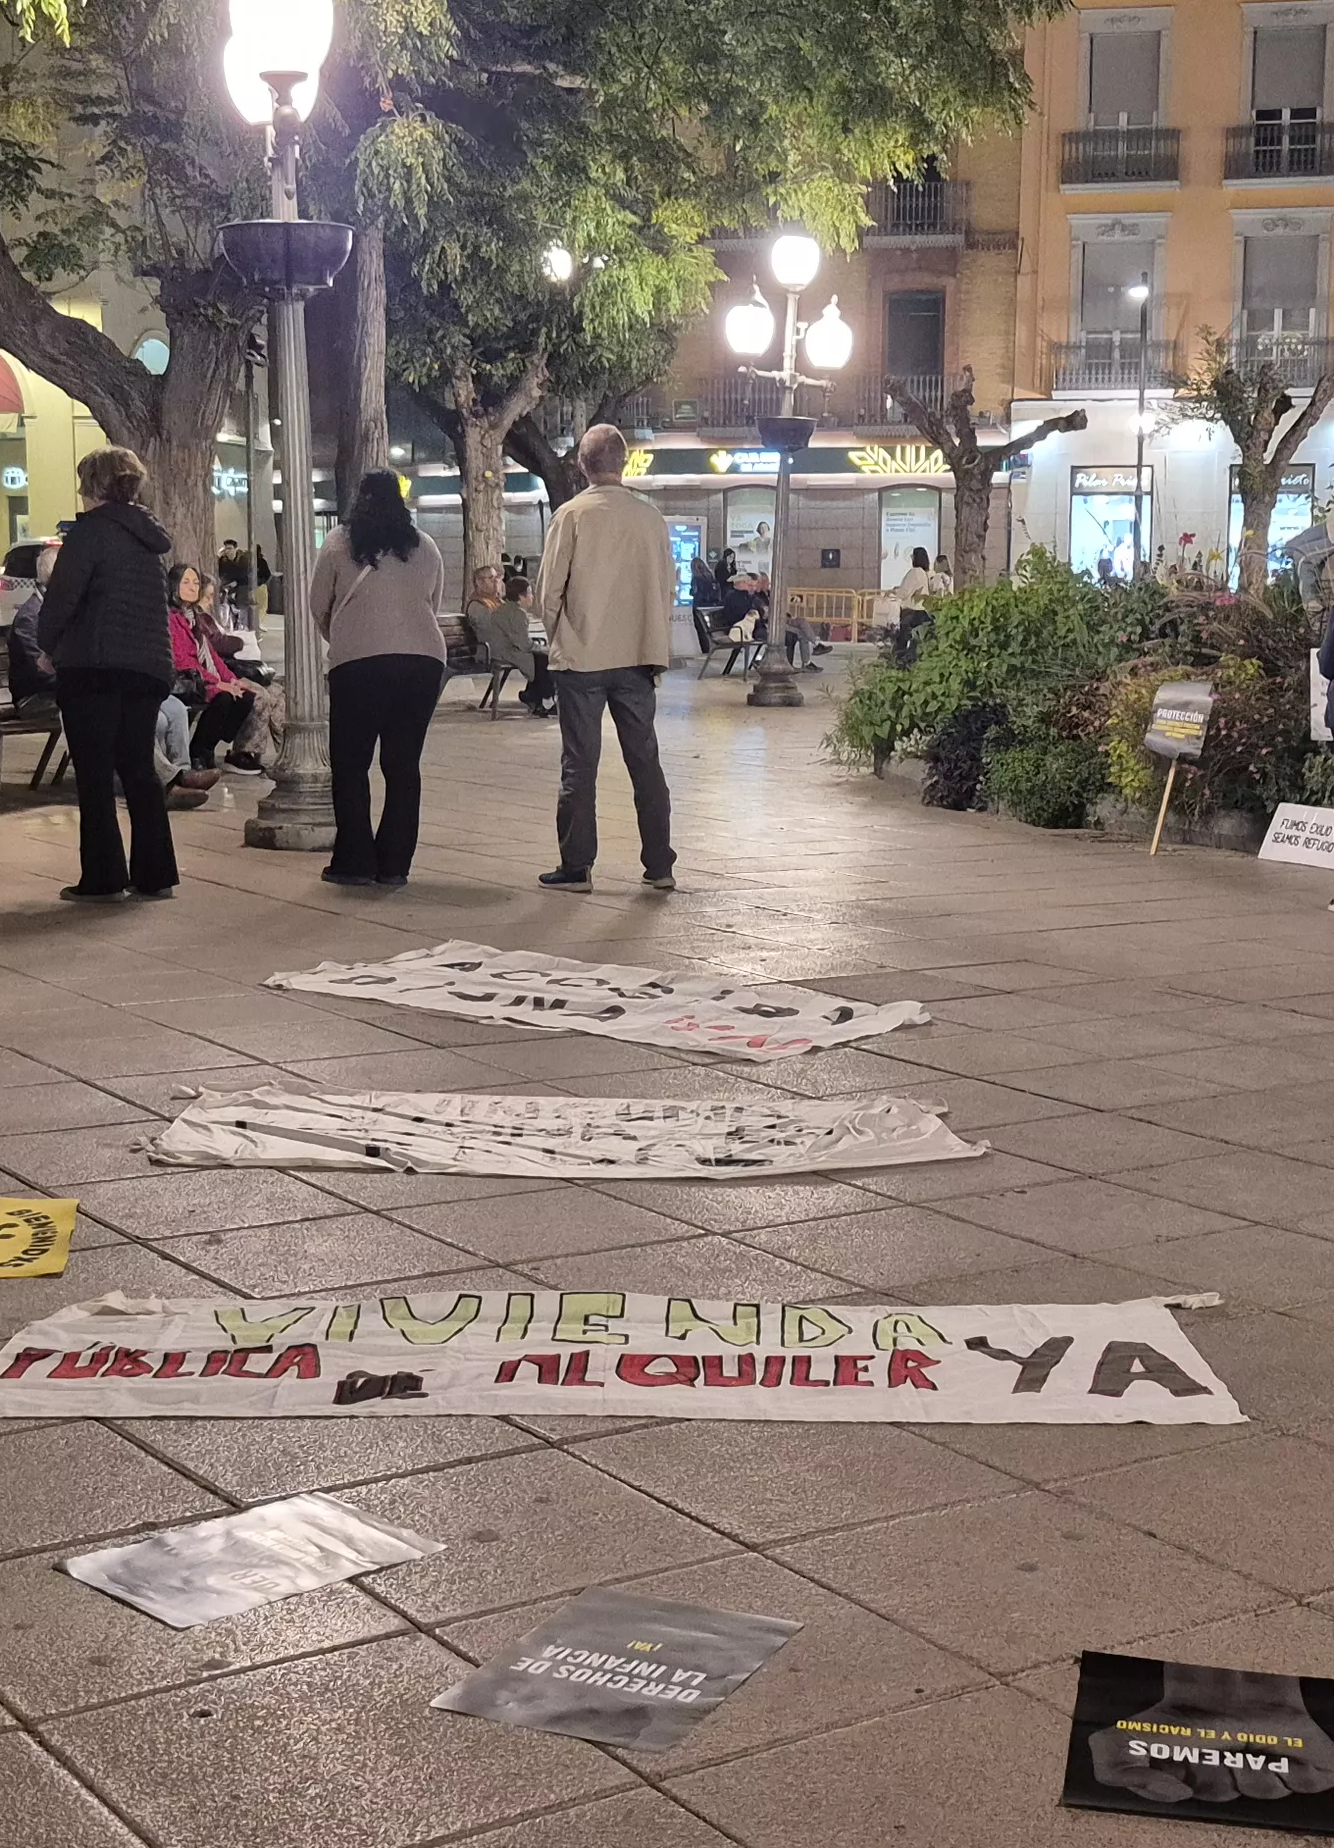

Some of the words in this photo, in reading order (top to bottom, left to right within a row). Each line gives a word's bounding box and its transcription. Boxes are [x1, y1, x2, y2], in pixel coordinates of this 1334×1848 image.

[1074, 472, 1109, 488] Pilar
[1156, 707, 1205, 723] PROTECCIÓN
[1280, 818, 1308, 833] FUIMOS
[1272, 831, 1301, 847] SEAMOS
[1302, 836, 1334, 853] REFUGIO
[213, 1292, 953, 1352] VIVIENDA
[333, 1368, 430, 1405] DE
[493, 1349, 939, 1392] ALQUILER
[962, 1335, 1215, 1398] YA
[509, 1656, 553, 1675] DE
[541, 1644, 667, 1680] INFANCIA
[553, 1664, 702, 1704] DERECHOS
[670, 1667, 707, 1686] LA
[1116, 1719, 1192, 1737] RACISMO
[1197, 1728, 1216, 1739] EL
[1221, 1730, 1232, 1741] Y
[1237, 1732, 1278, 1746] ODIO
[1283, 1736, 1303, 1748] EL
[1127, 1739, 1290, 1774] PAREMOS
